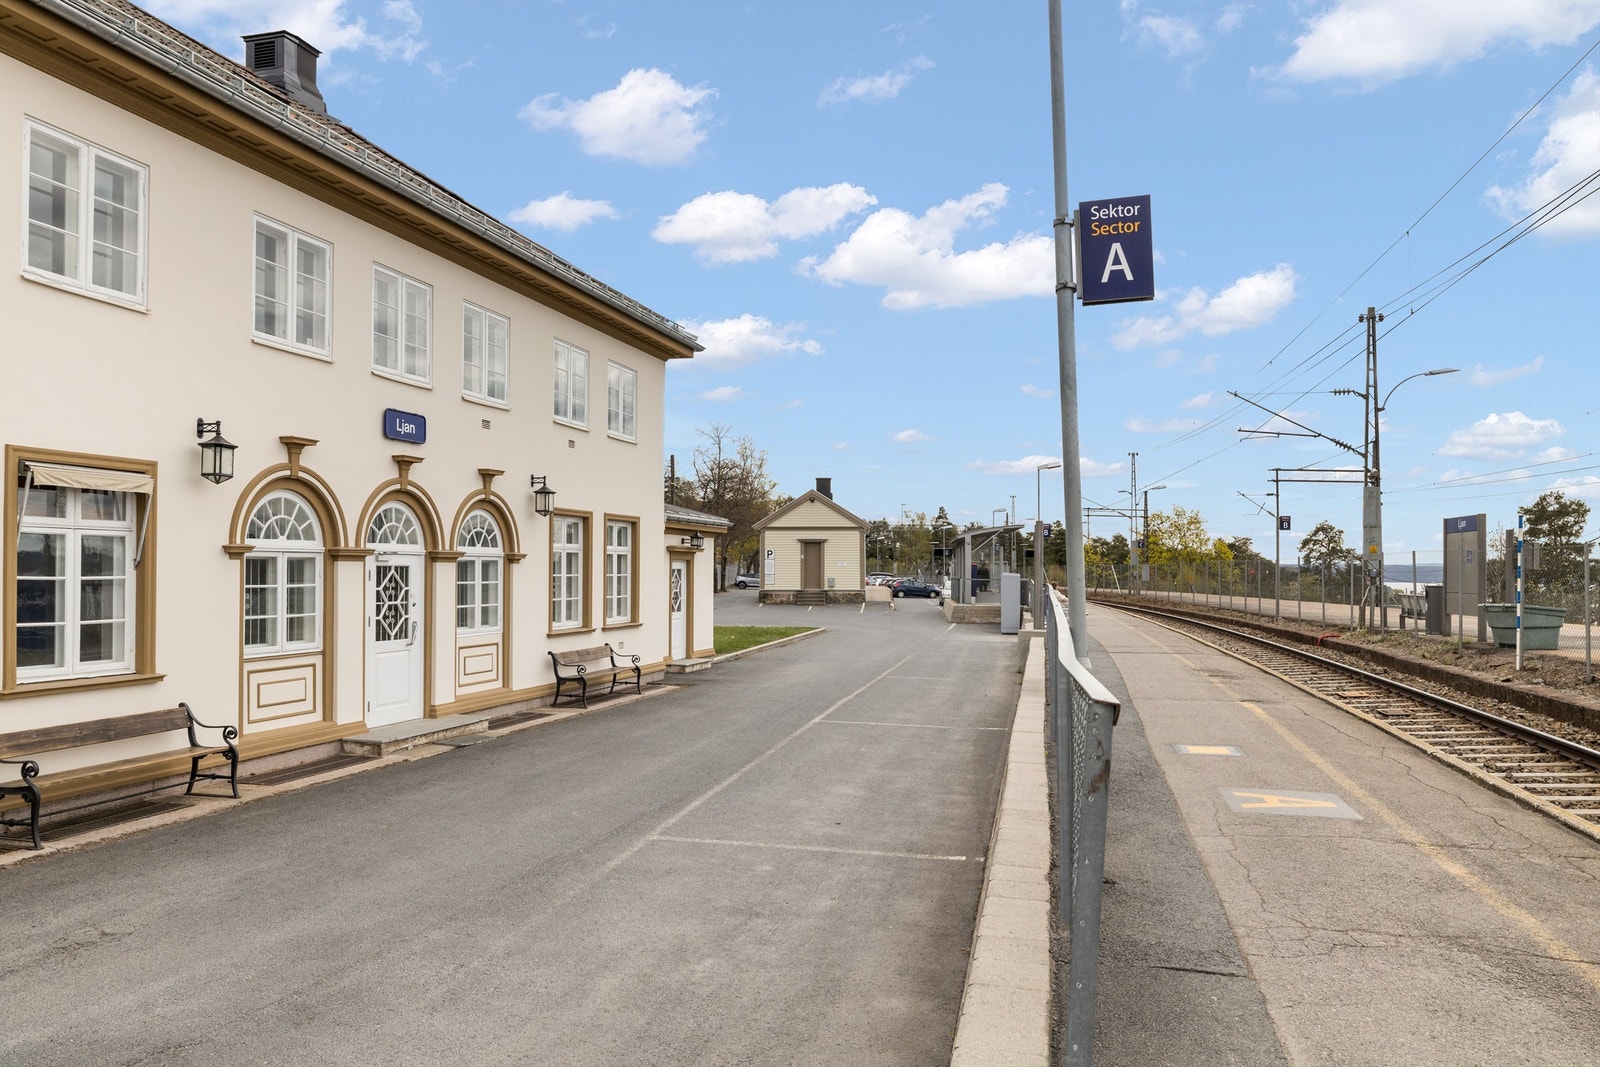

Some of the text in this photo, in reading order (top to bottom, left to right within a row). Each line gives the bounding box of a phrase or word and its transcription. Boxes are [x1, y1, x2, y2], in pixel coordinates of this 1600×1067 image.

[1090, 204, 1141, 220] Sektor
[1091, 221, 1141, 237] Sector
[1100, 242, 1135, 283] A
[396, 418, 416, 435] Ljan
[1458, 519, 1466, 530] Ljan
[767, 550, 773, 559] P
[1232, 791, 1338, 808] A
